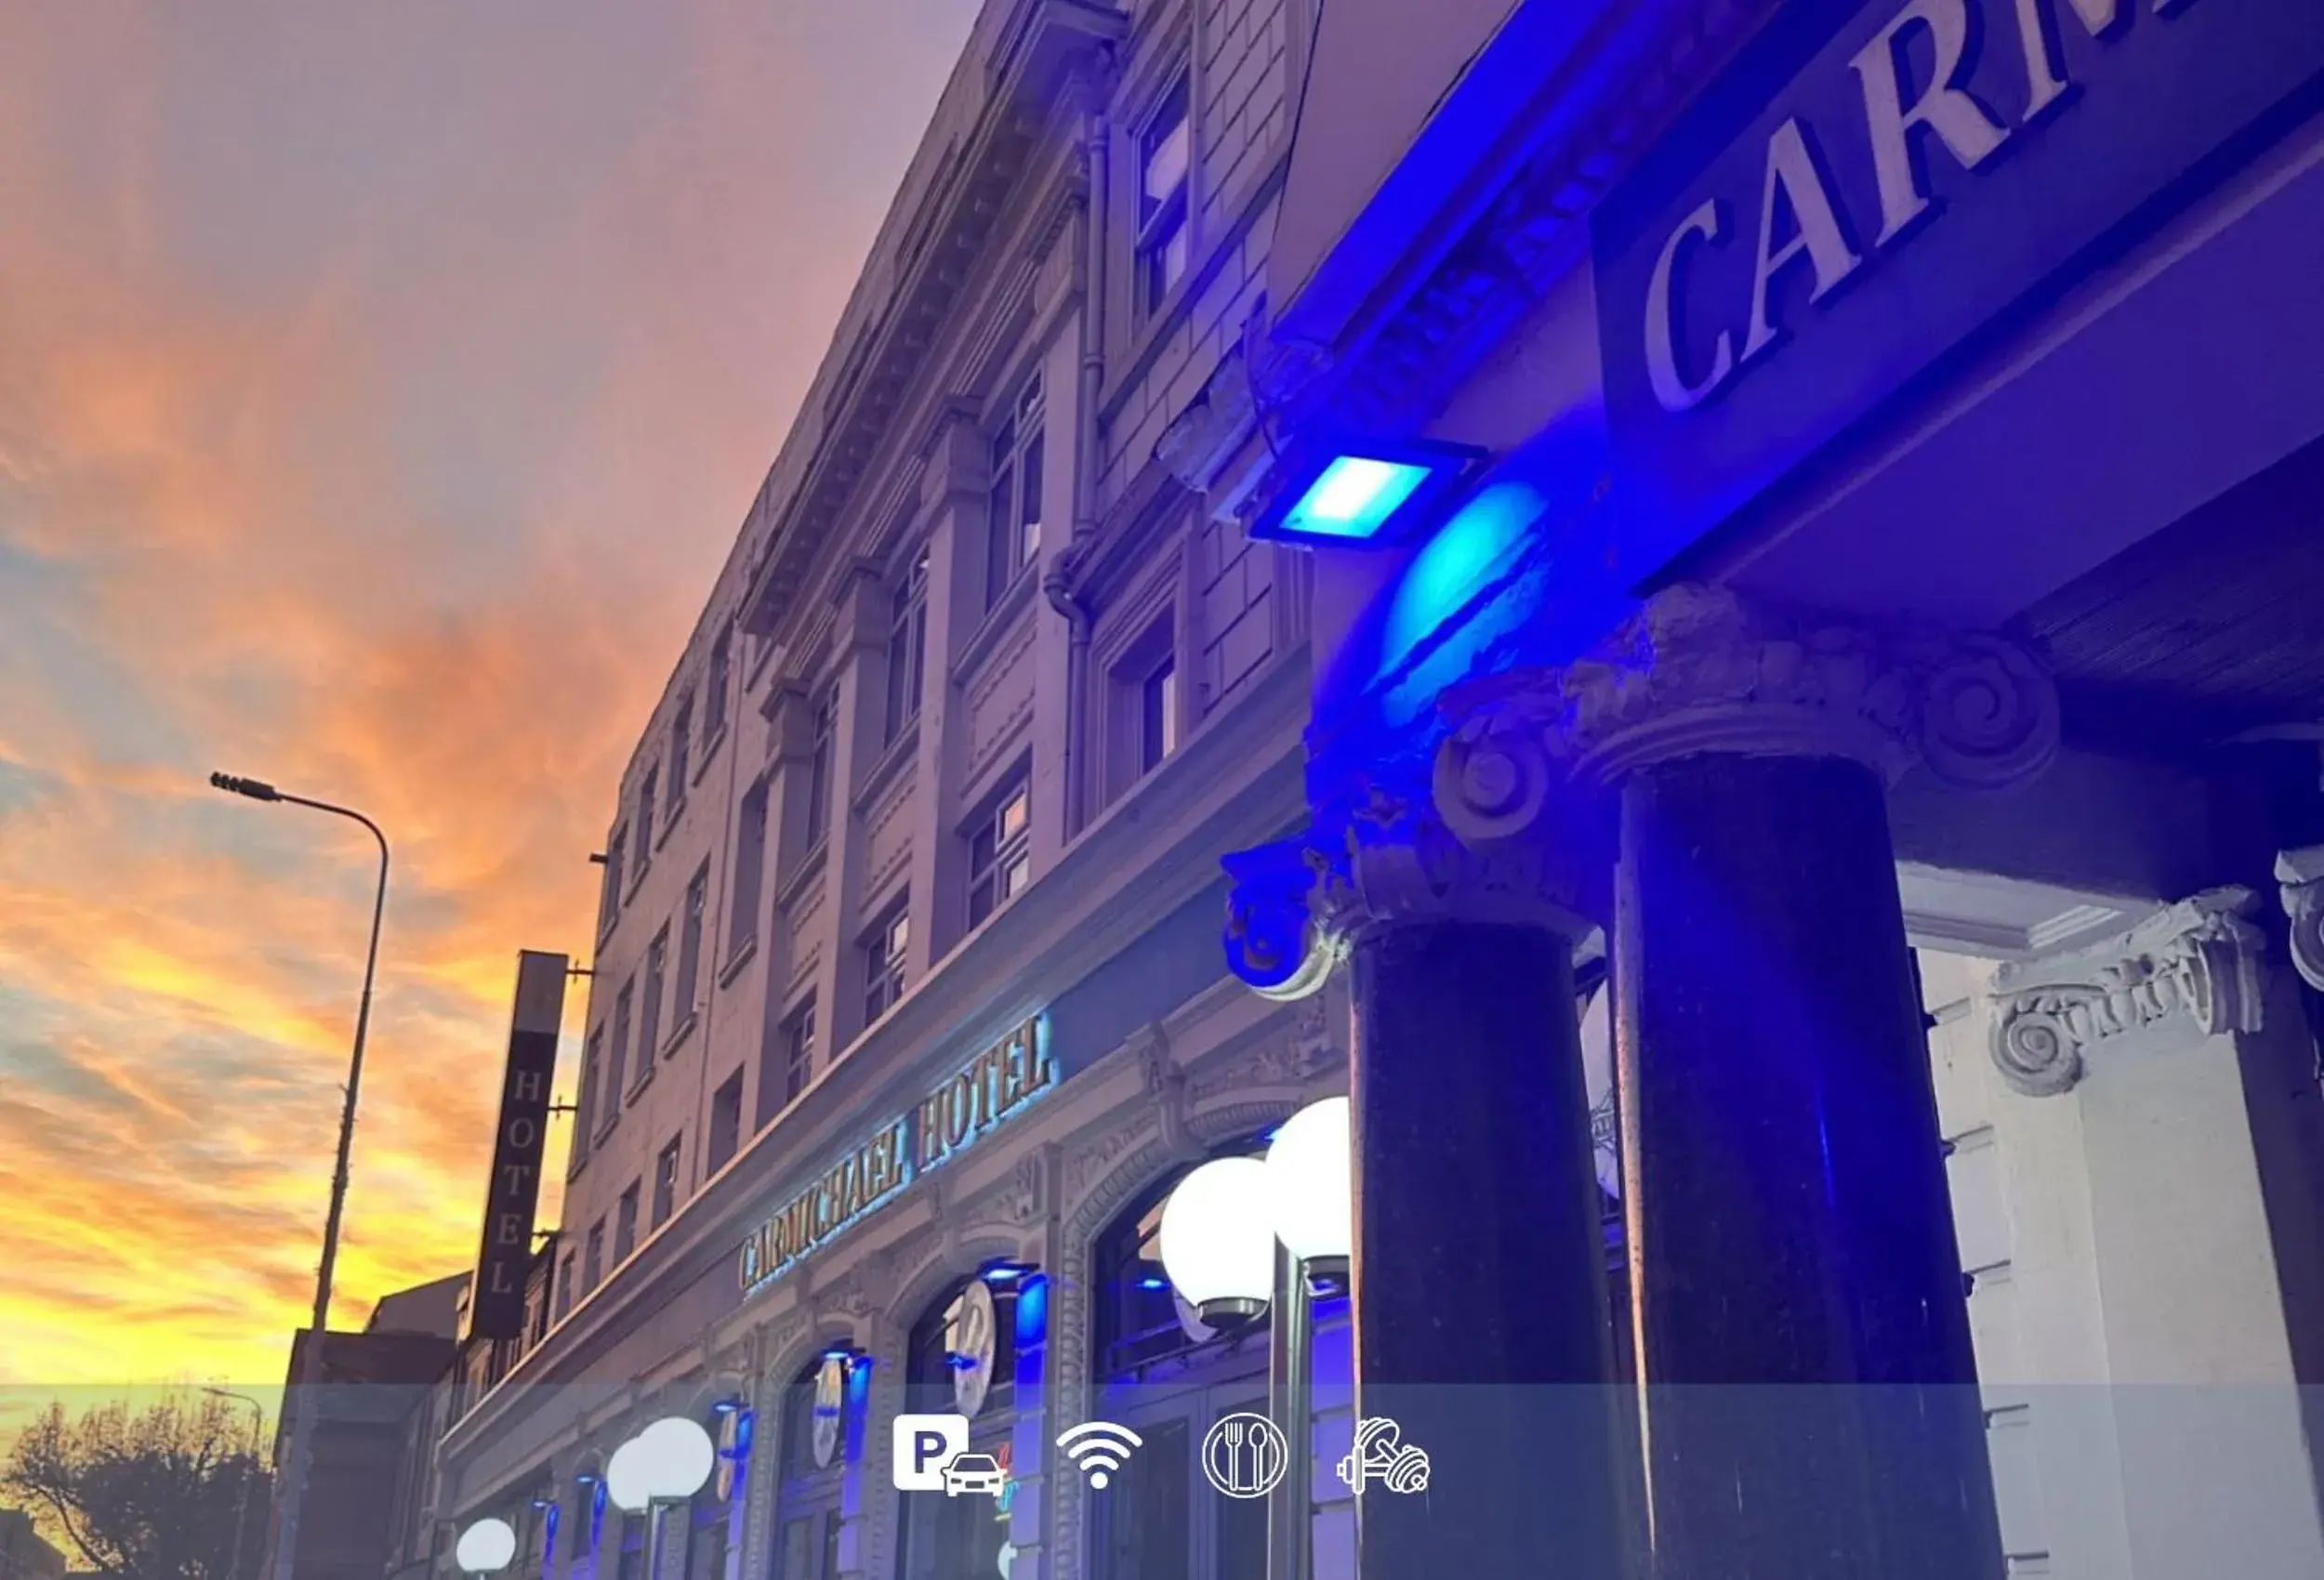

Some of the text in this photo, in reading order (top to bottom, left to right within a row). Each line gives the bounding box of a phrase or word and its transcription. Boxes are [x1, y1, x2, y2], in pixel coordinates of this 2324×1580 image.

[490, 1069, 542, 1294] HOTEL
[739, 1014, 1053, 1290] CARMICHAEL HOTEL
